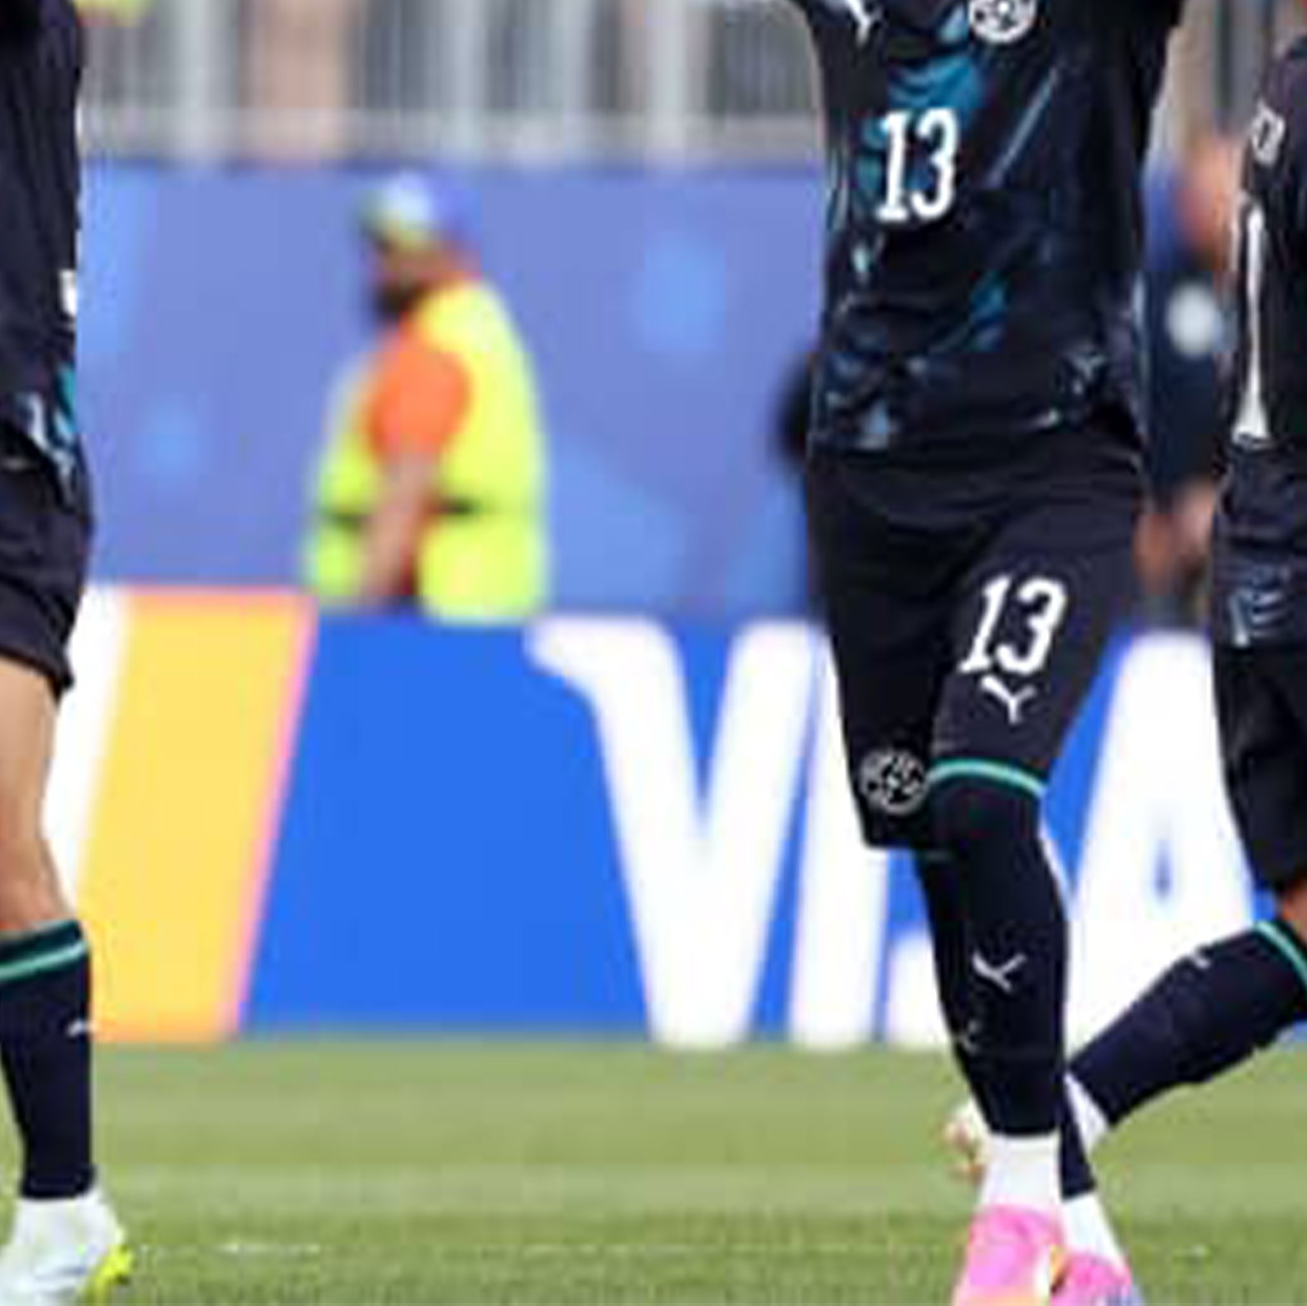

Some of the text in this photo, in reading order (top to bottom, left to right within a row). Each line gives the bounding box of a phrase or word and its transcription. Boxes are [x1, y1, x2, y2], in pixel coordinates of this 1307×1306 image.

[875, 107, 958, 222] 13
[958, 575, 1065, 675] 13
[523, 614, 1257, 1050] VIA
